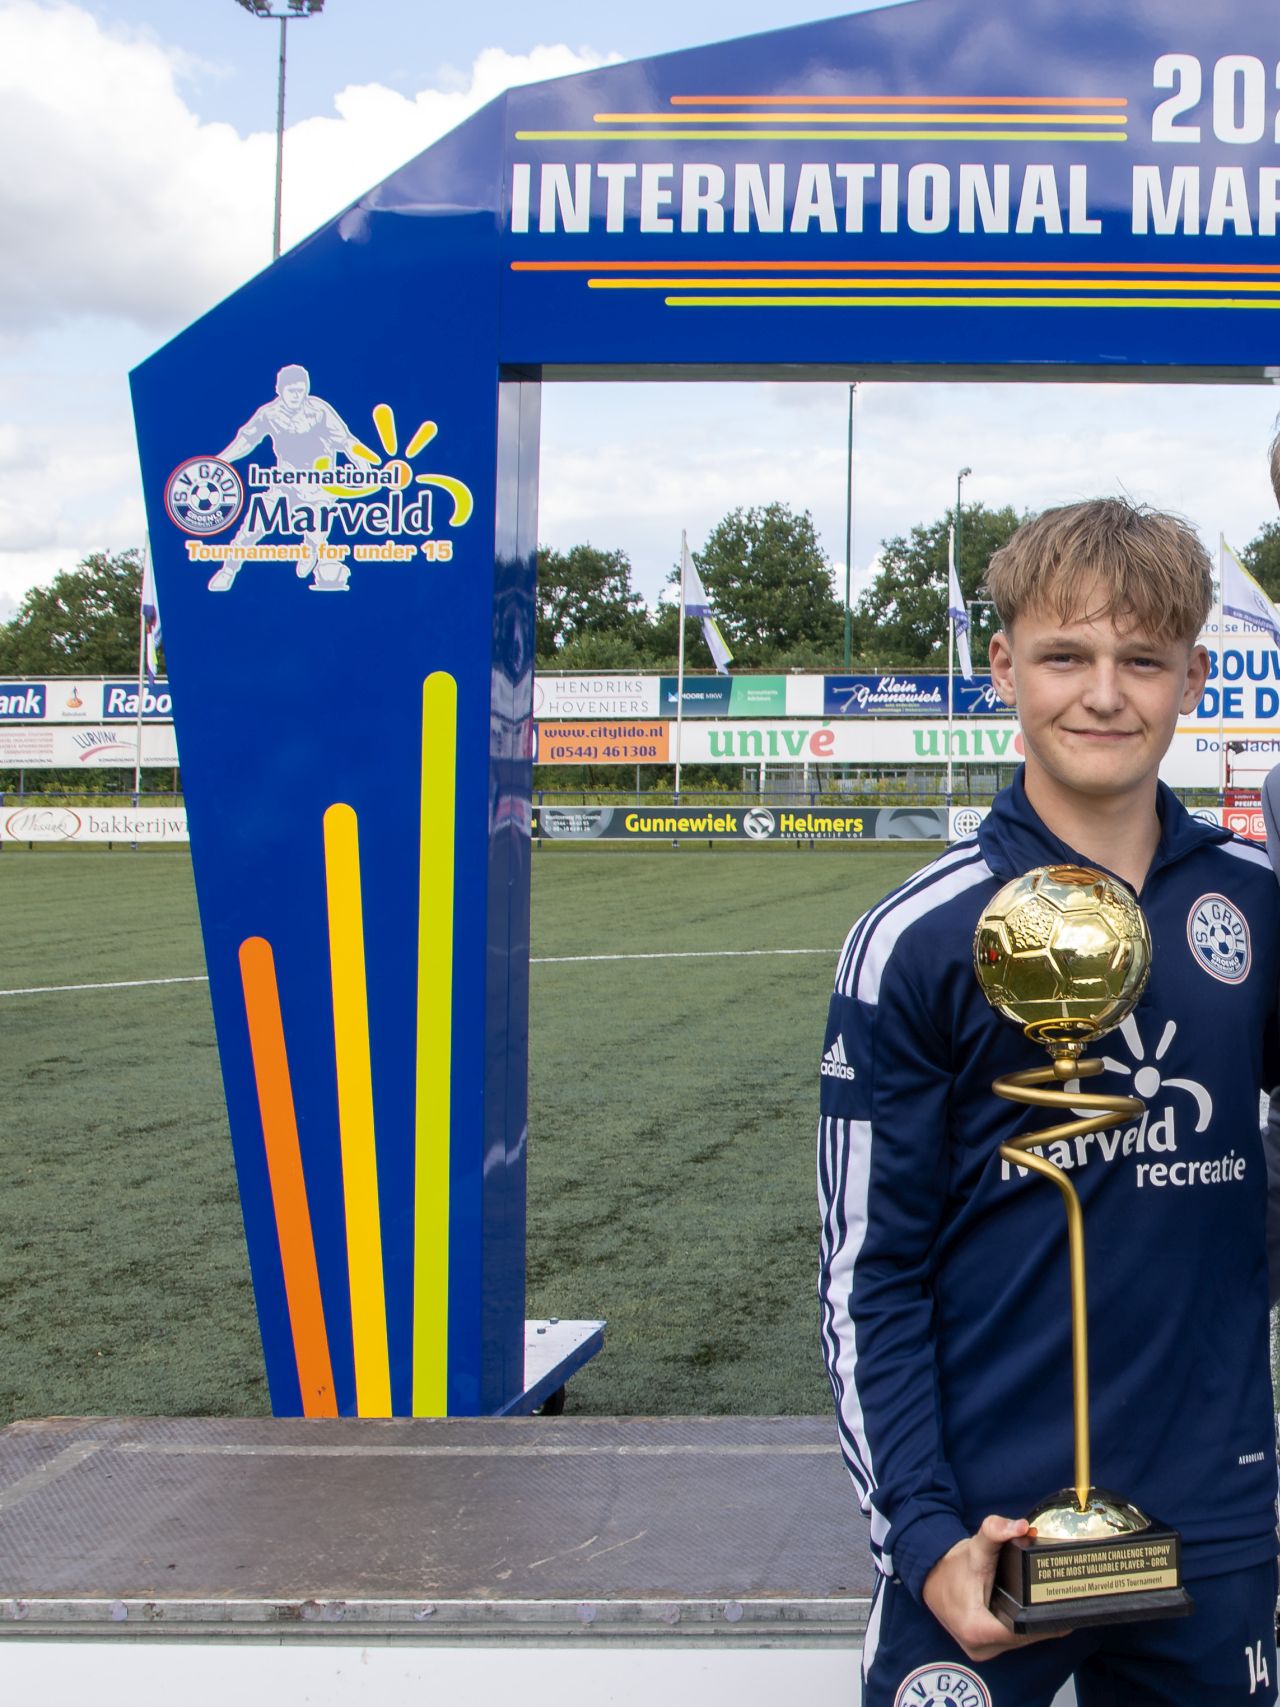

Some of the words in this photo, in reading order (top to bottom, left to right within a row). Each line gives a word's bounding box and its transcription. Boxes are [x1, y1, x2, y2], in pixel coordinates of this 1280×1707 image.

[510, 163, 1102, 234] INTERNATIONAL
[199, 464, 236, 502] GROL
[250, 466, 400, 485] International
[247, 491, 433, 535] Marveld
[187, 541, 310, 561] Tournament
[318, 542, 349, 561] for
[355, 541, 415, 561] under
[421, 541, 452, 561] 15
[555, 680, 643, 693] HENDRIKS
[877, 676, 917, 693] Klein
[549, 700, 649, 713] HOVENIERS
[1197, 687, 1244, 719] DE
[544, 726, 663, 740] www.citylido.nl
[708, 719, 836, 758] univé
[550, 746, 598, 760] (0544)
[602, 745, 657, 758] 461308
[624, 813, 738, 833] Gunnewiek
[780, 813, 864, 833] Helmers
[1211, 904, 1245, 948] GROL
[820, 1060, 855, 1080] adidas
[1136, 1149, 1247, 1188] recreatie
[1036, 1558, 1050, 1569] THE
[1051, 1555, 1073, 1567] TONNY
[1073, 1551, 1107, 1564] HARTMAN
[1107, 1547, 1144, 1560] CHALLENGE
[1144, 1545, 1171, 1557] TROPHY
[1038, 1569, 1052, 1580] FOR
[1052, 1568, 1066, 1578] THE
[1066, 1565, 1086, 1577] MOST
[1086, 1561, 1120, 1574] VALUABLE
[1119, 1559, 1145, 1571] PLAYER
[1150, 1556, 1168, 1568] GROL
[1046, 1583, 1087, 1596] International
[1126, 1576, 1163, 1588] Tournament
[1244, 1640, 1270, 1695] 14
